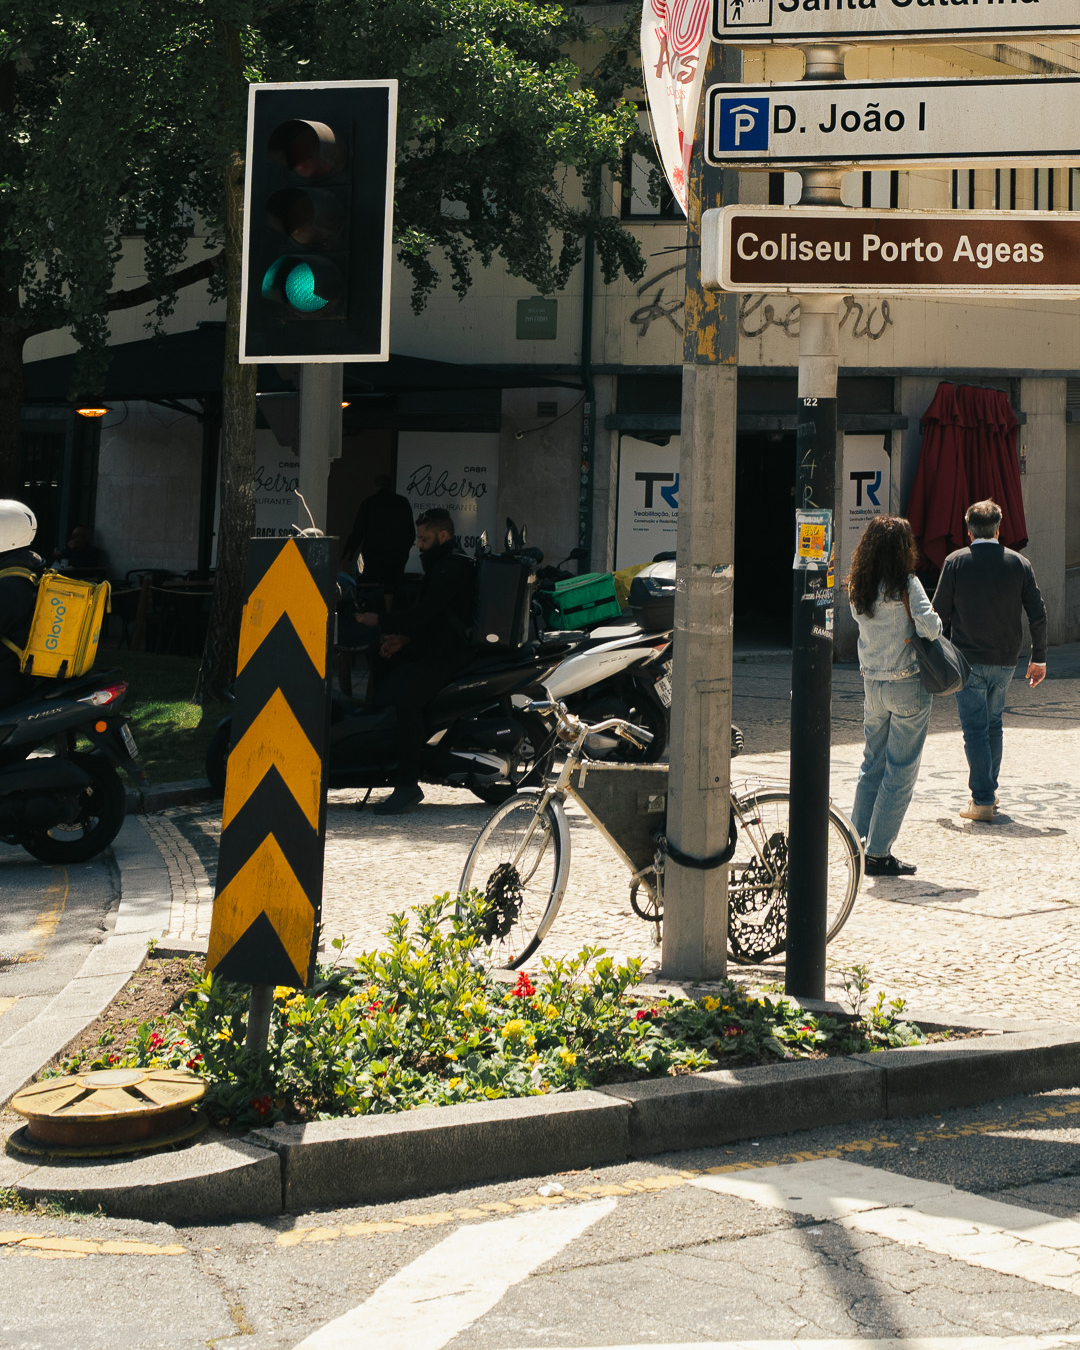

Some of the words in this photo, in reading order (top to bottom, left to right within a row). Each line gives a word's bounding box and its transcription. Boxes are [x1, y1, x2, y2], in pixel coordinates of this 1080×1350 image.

[773, 104, 806, 134] D.
[818, 102, 905, 134] João
[918, 101, 926, 131] I
[736, 232, 851, 262] Coliseu
[862, 233, 944, 263] Porto
[952, 235, 1045, 269] Ageas
[803, 398, 818, 407] 122
[255, 465, 300, 493] beiro
[406, 464, 488, 499] Ribeiro
[463, 466, 487, 474] CASA
[254, 497, 293, 506] AURANTE
[413, 501, 479, 512] RESTAURANTE
[44, 597, 67, 650] Glovo
